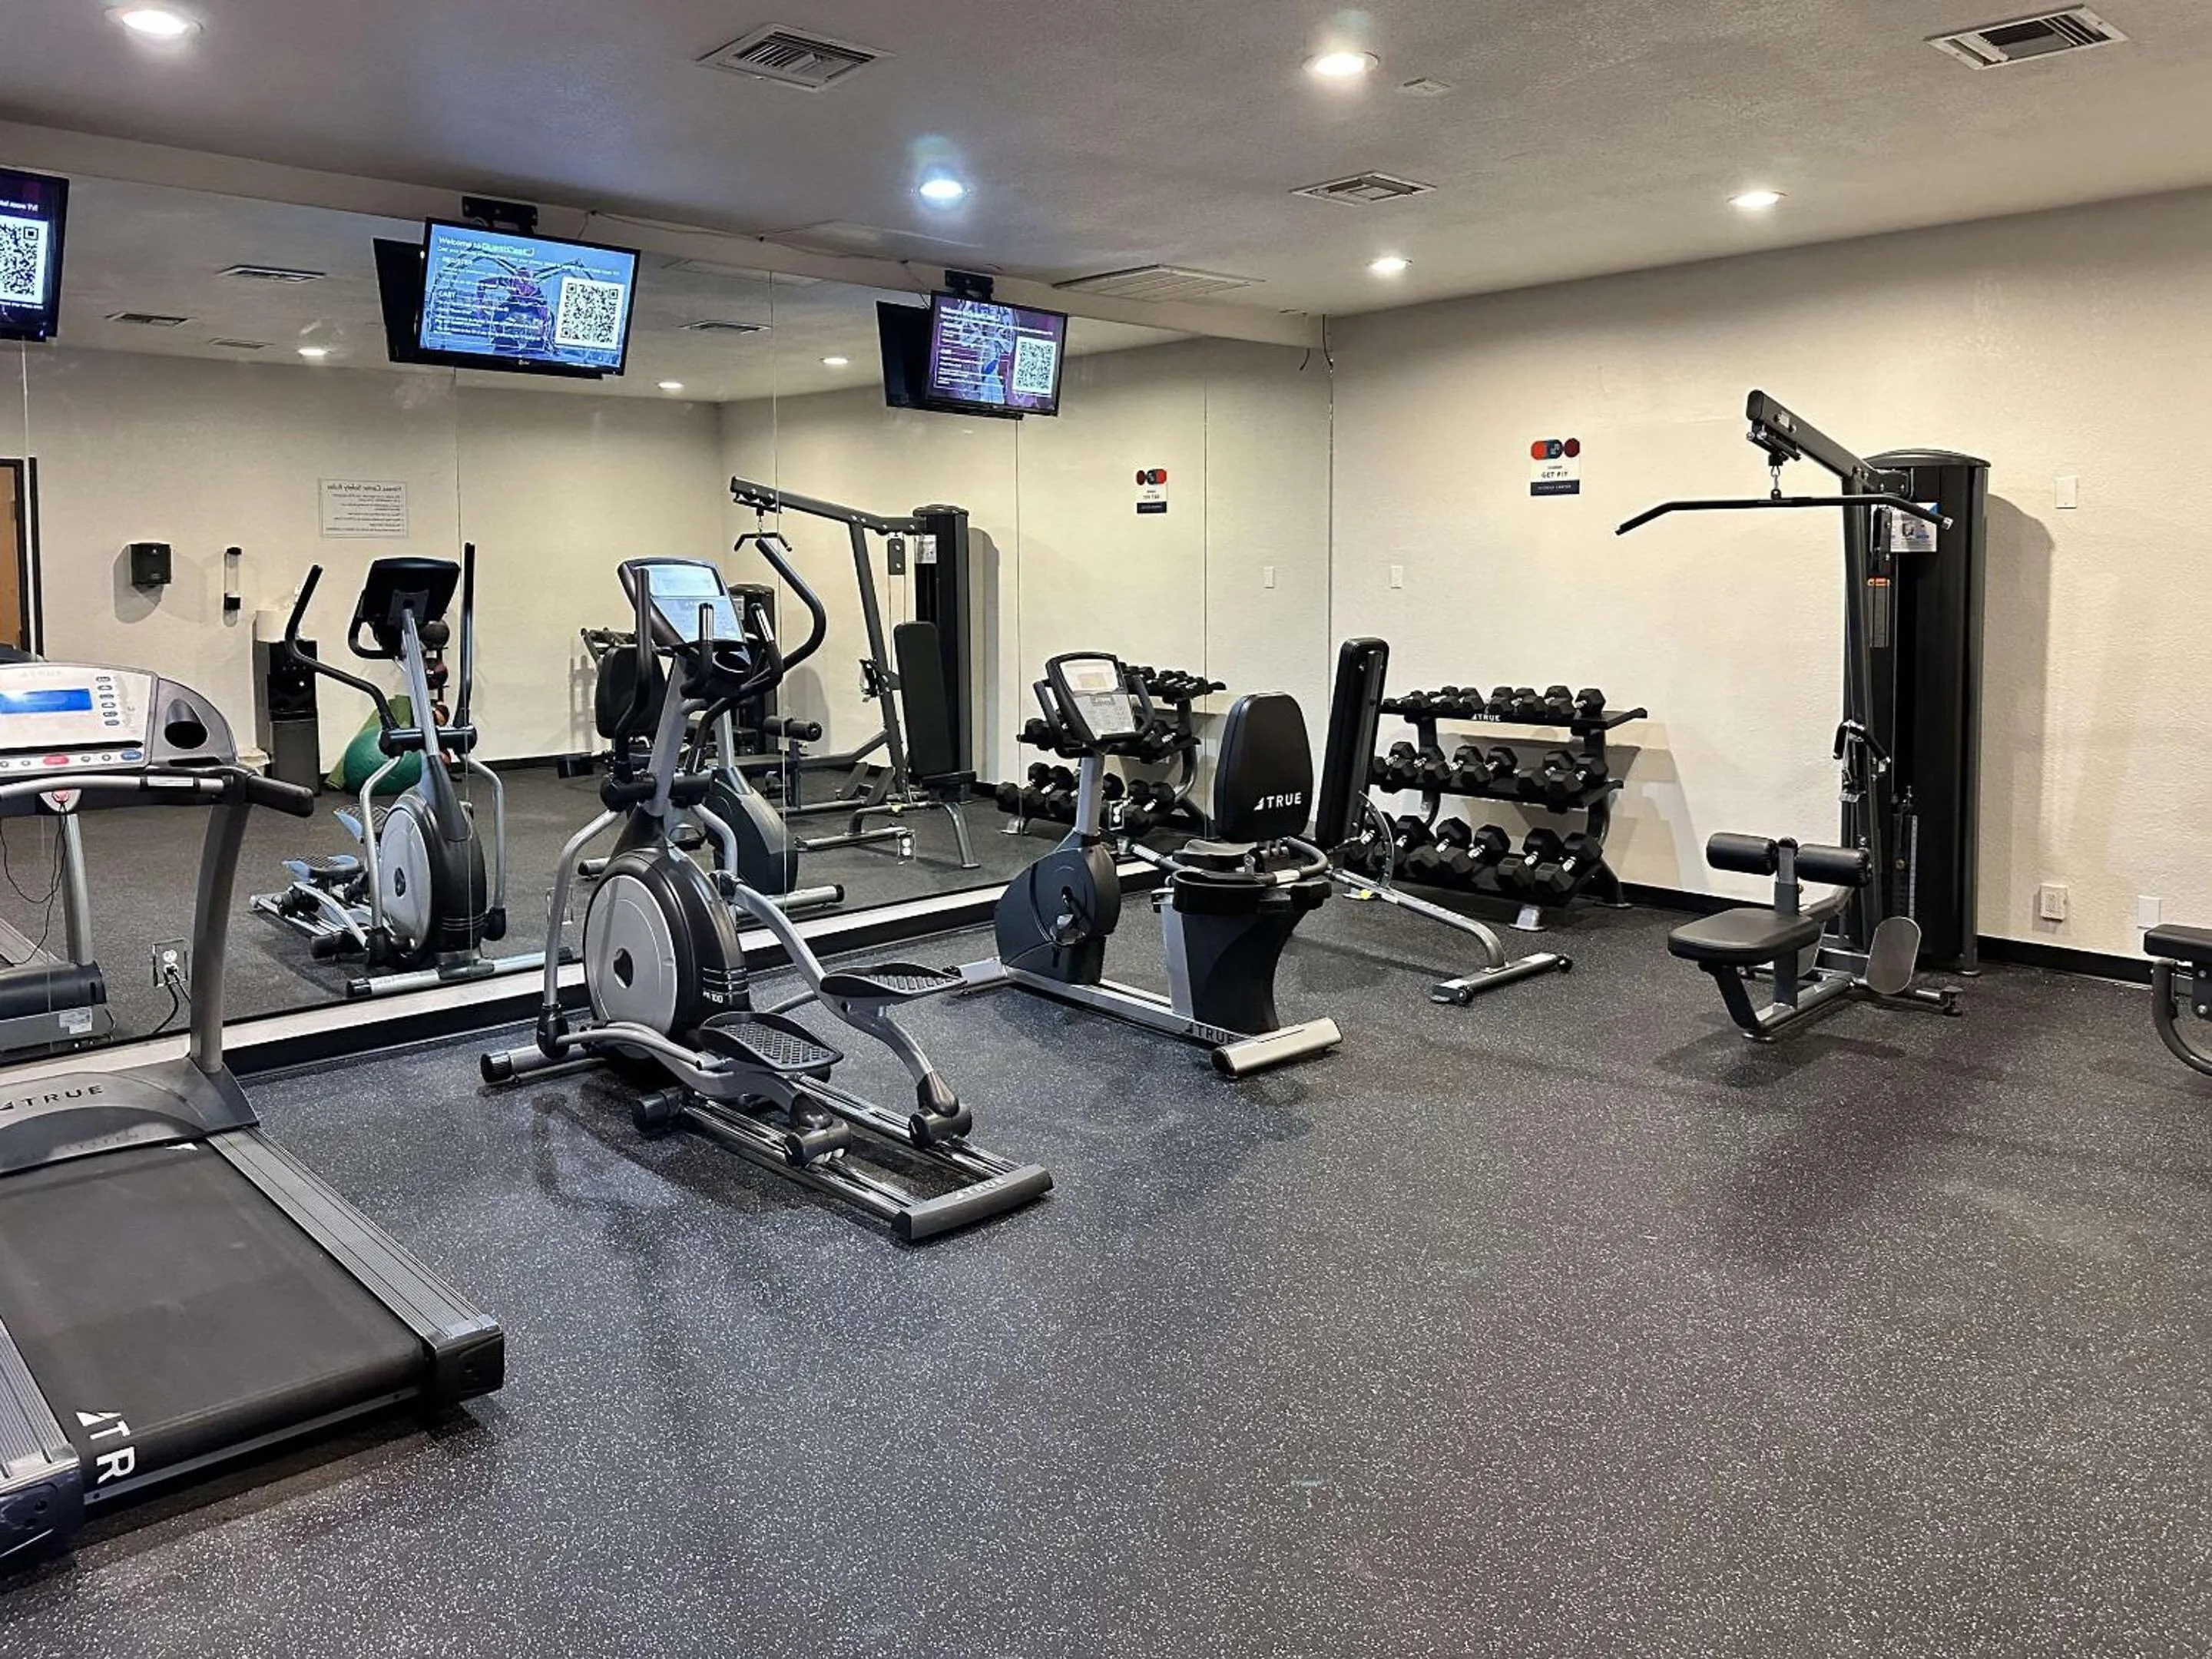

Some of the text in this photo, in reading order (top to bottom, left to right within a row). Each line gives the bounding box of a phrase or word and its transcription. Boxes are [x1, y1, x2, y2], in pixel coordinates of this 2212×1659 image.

[439, 236, 472, 248] Welcome
[1478, 713, 1502, 722] TRUE
[1267, 792, 1302, 809] TRUE
[1195, 1023, 1233, 1045] TRUE
[21, 1084, 104, 1107] TRUE
[962, 1178, 1006, 1194] TRUE
